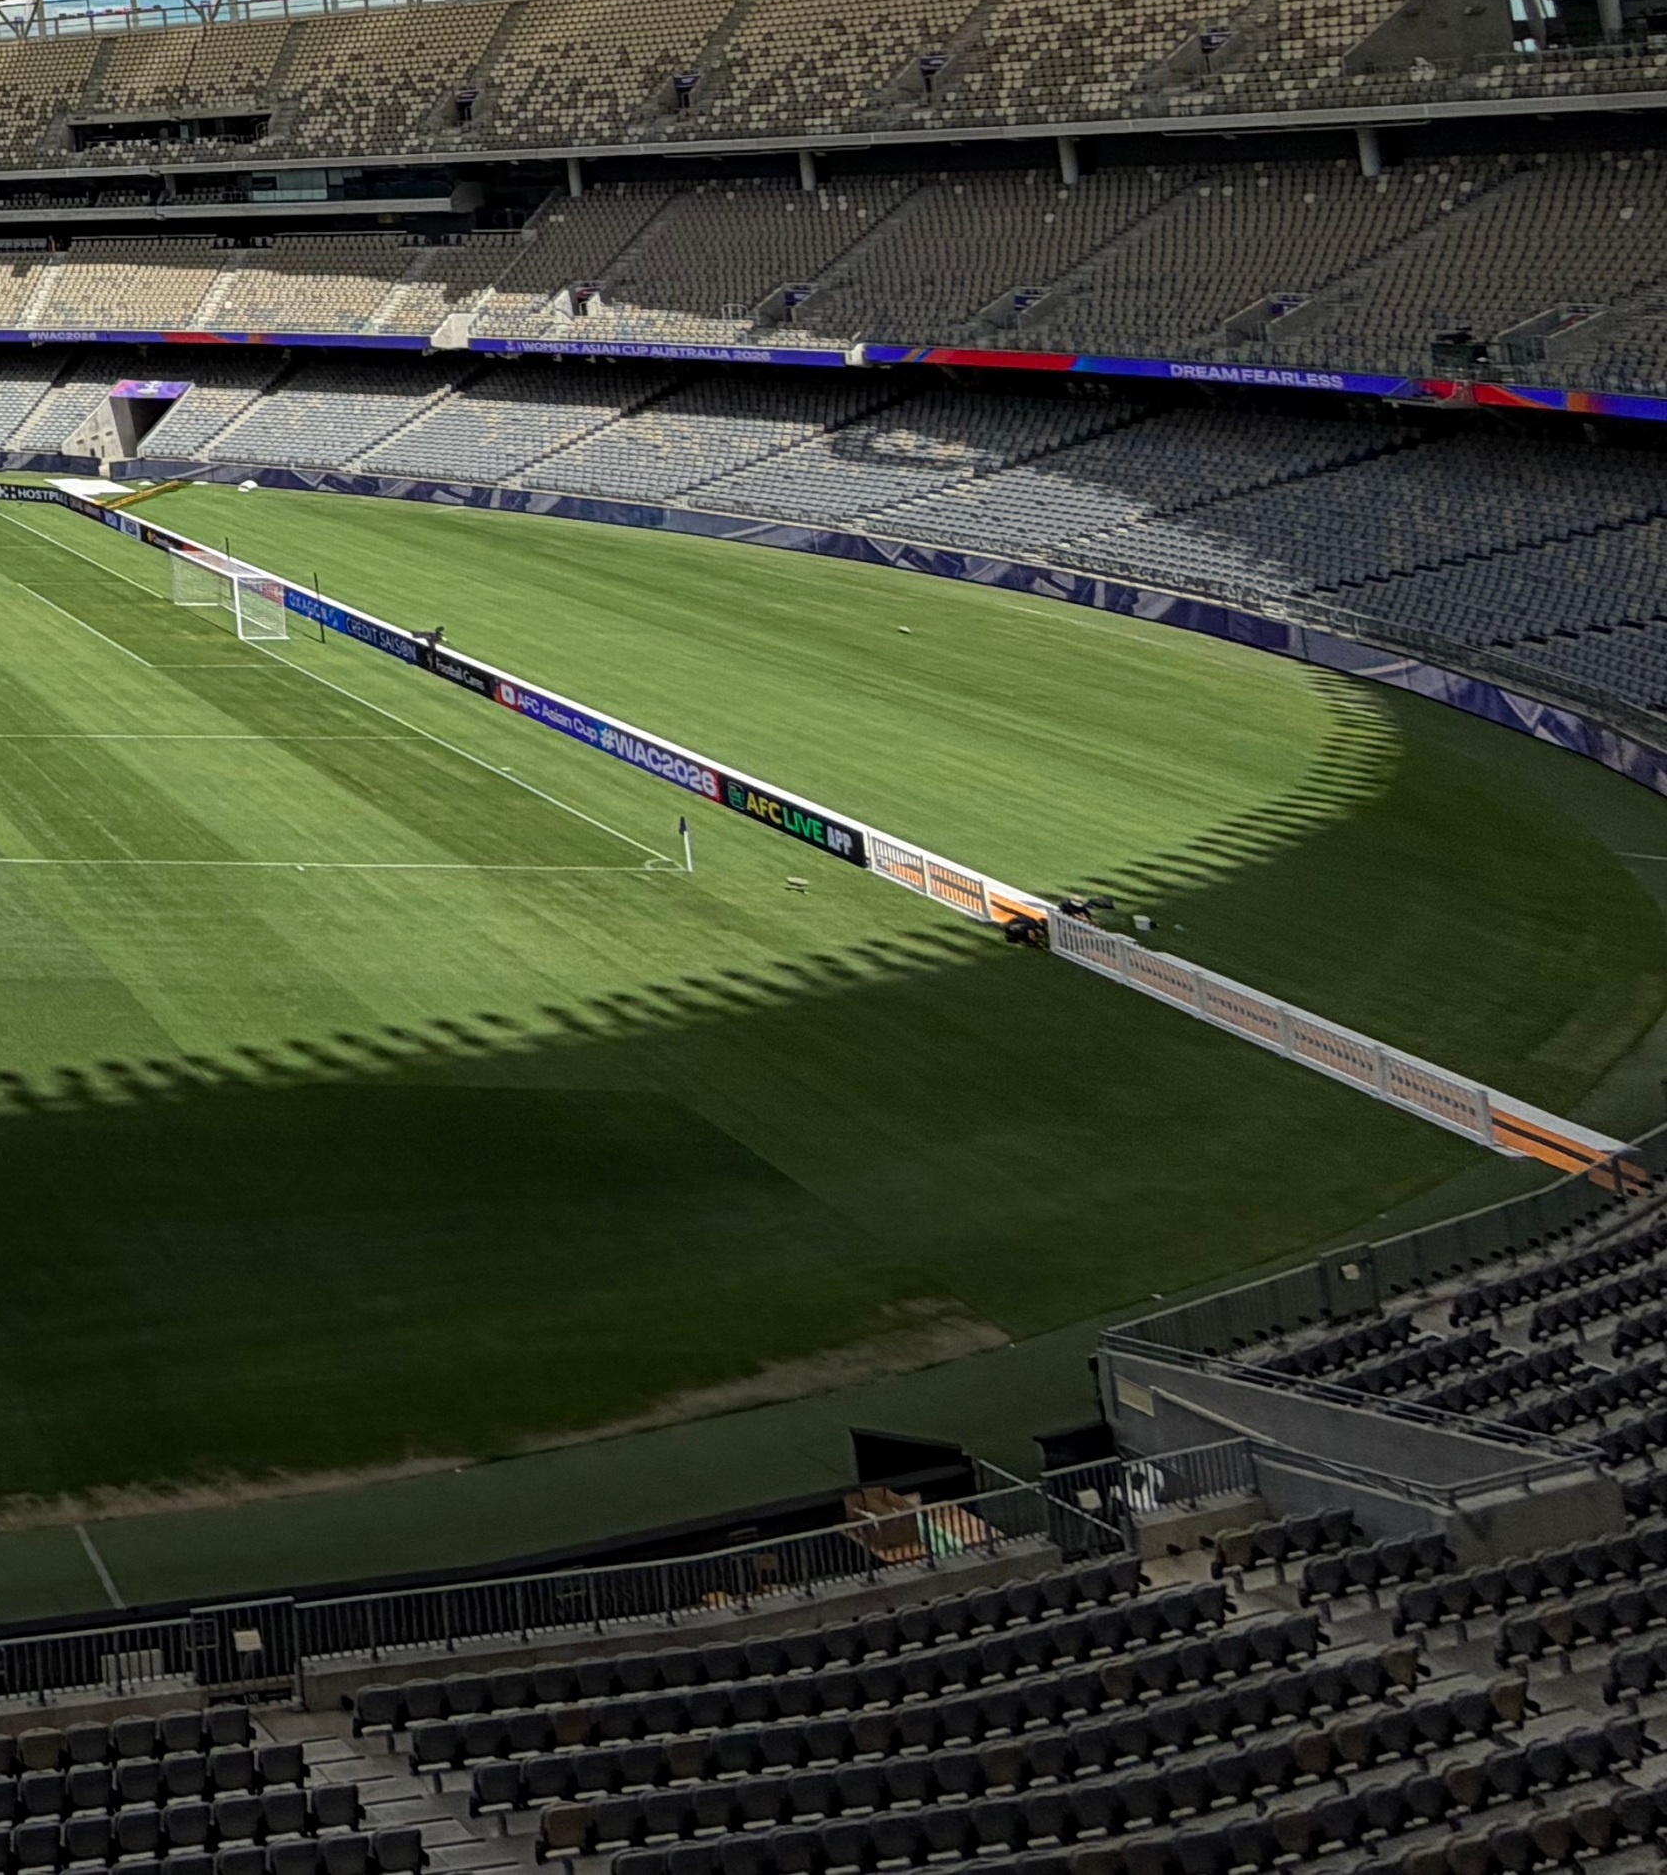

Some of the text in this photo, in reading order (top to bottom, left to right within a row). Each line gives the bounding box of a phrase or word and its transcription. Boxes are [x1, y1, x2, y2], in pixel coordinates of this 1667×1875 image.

[618, 343, 647, 357] CUP
[650, 346, 729, 361] AUSTRALIA
[1170, 363, 1344, 389] DREAM FEARLESS
[345, 616, 378, 642] CREDIT
[517, 693, 598, 742] AFC Asian Cup
[600, 726, 718, 797] #WAC2026
[747, 791, 853, 856] AFC LIVE APP
